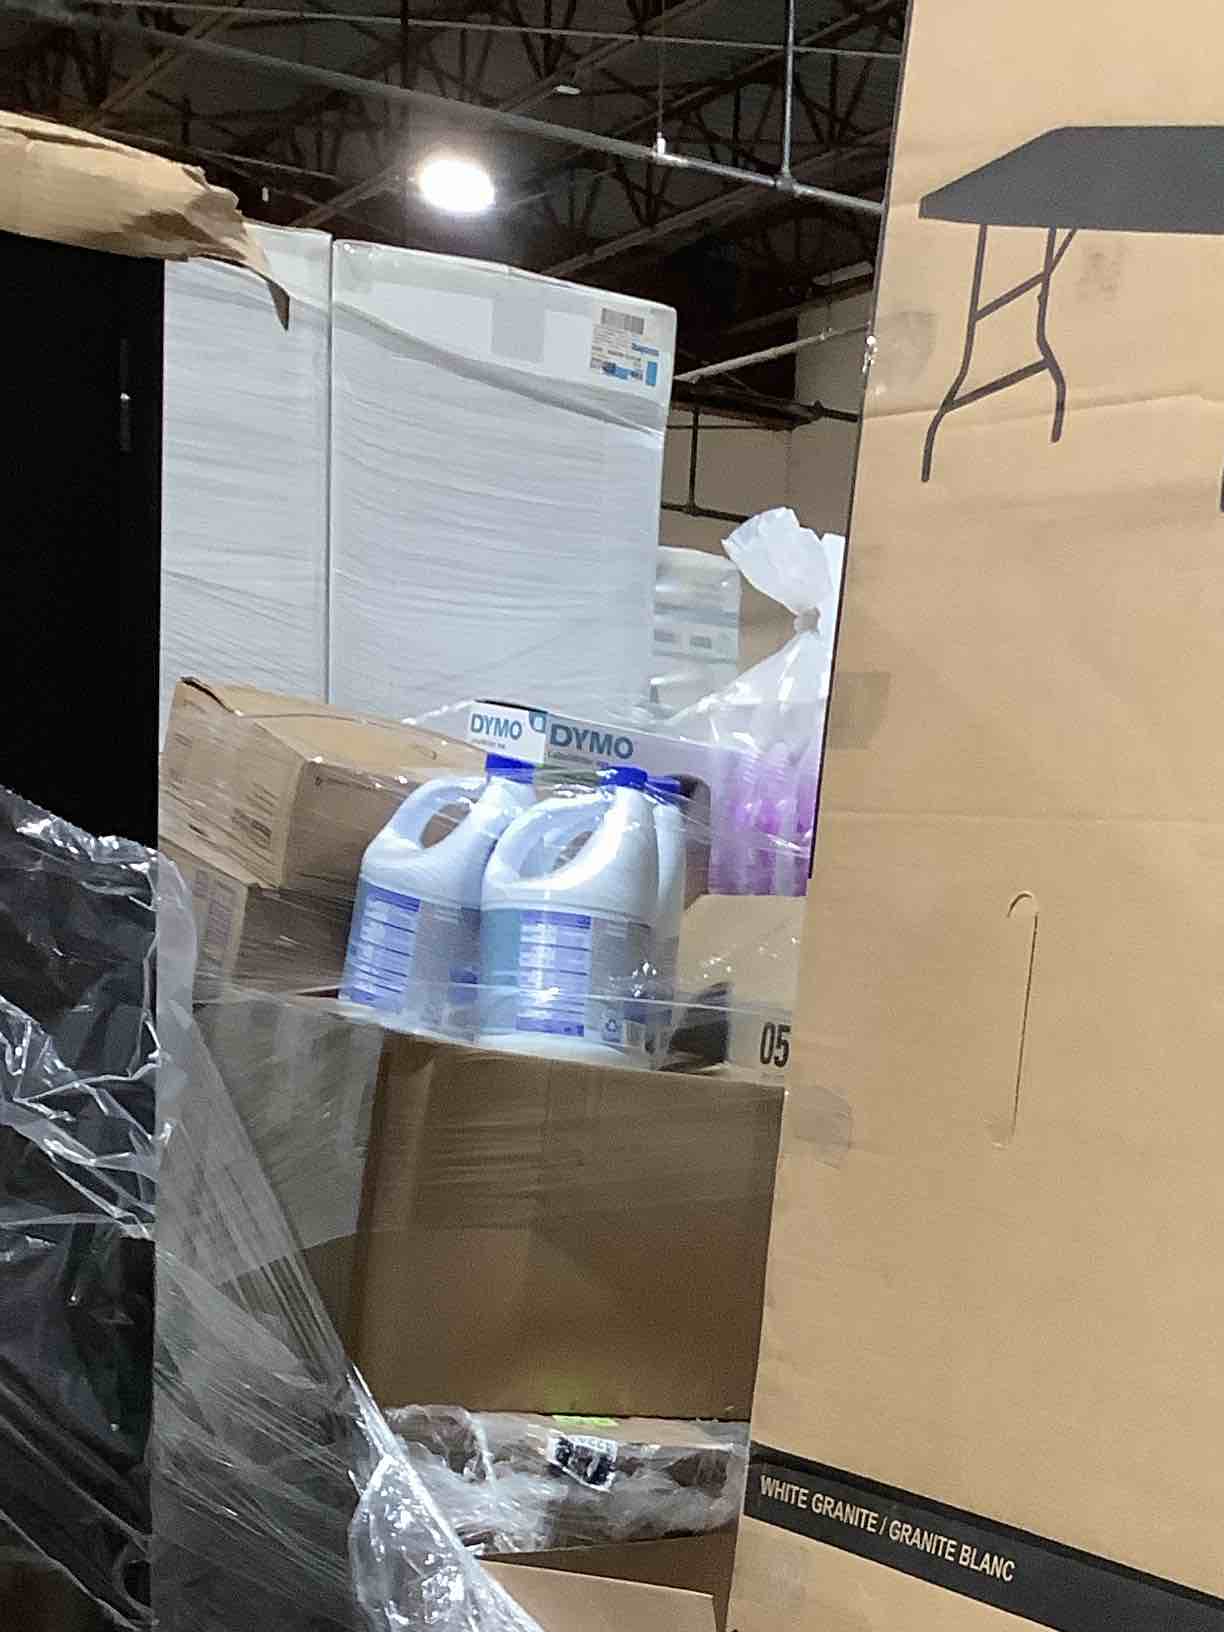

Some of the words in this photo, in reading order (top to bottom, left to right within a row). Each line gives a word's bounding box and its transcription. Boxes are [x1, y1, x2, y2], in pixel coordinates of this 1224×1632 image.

[471, 713, 522, 740] DYMO
[551, 723, 634, 759] DYMO
[760, 1474, 809, 1511] WHITE
[811, 1493, 879, 1535] GRANITE
[878, 1516, 888, 1536] /
[888, 1519, 956, 1562] GRANITE
[958, 1543, 1018, 1584] BLANC
